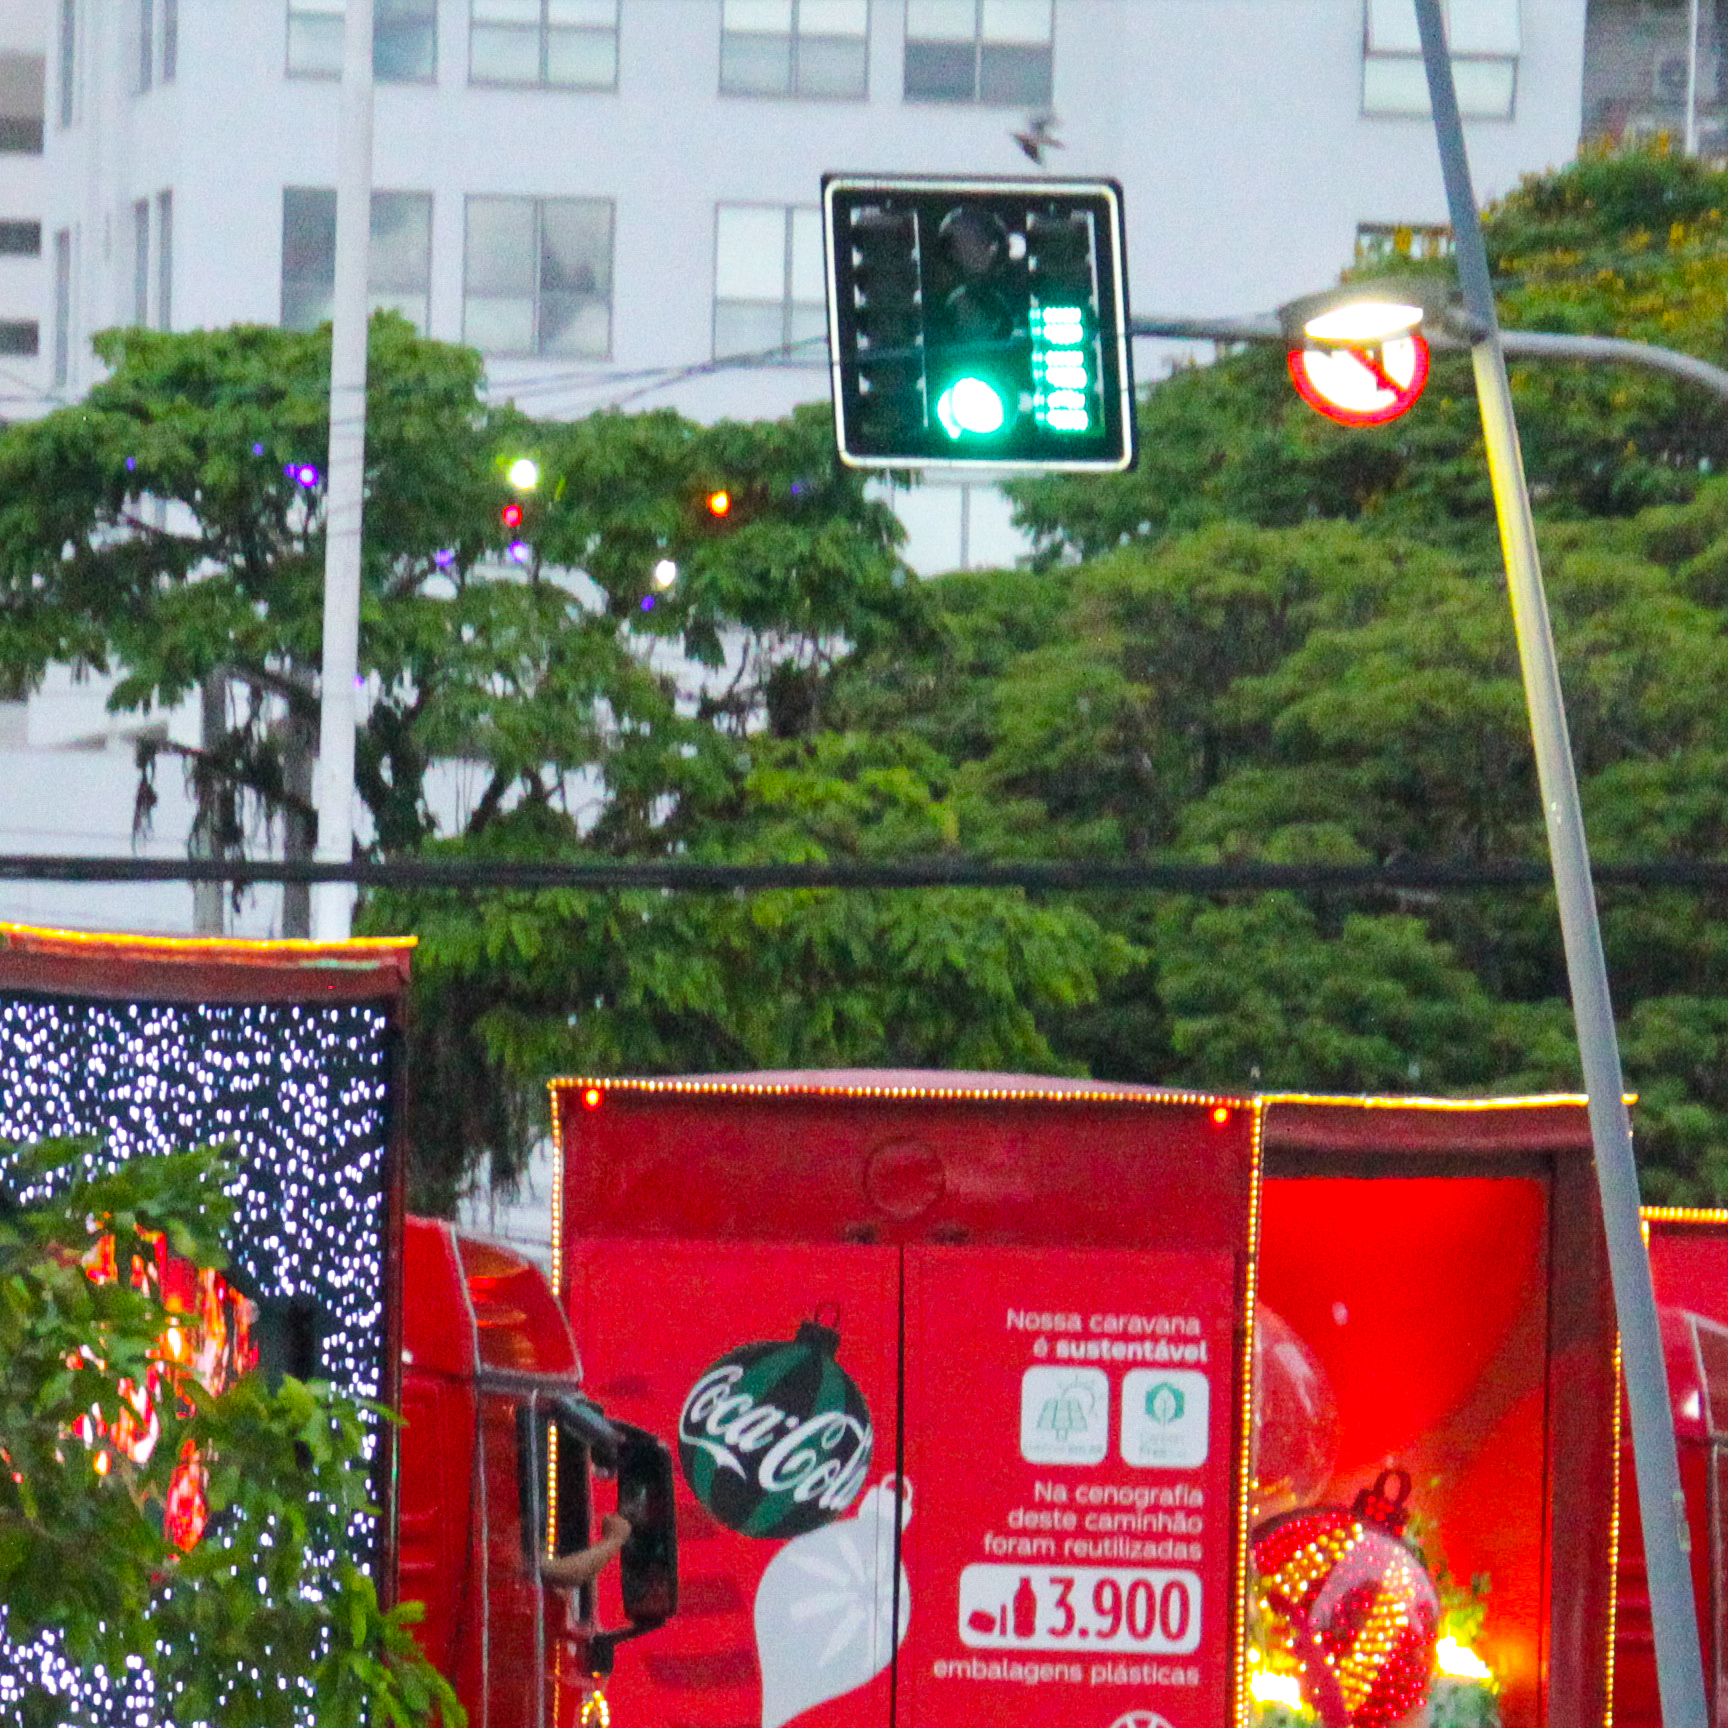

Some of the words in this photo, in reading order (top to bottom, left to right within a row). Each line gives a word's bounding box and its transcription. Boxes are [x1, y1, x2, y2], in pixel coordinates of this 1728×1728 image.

[1006, 1308, 1083, 1333] Nossa
[1089, 1312, 1201, 1336] caravana
[1055, 1337, 1208, 1363] sustentável
[1034, 1480, 1068, 1503] Na
[1075, 1482, 1204, 1510] cenografia
[1008, 1506, 1077, 1531] deste
[1084, 1508, 1203, 1534] caminhão
[983, 1530, 1056, 1557] foram
[1064, 1533, 1203, 1562] reutilizadas
[1046, 1575, 1191, 1643] 3.900
[933, 1658, 1084, 1685] embalagens
[1090, 1661, 1200, 1687] plásticas
